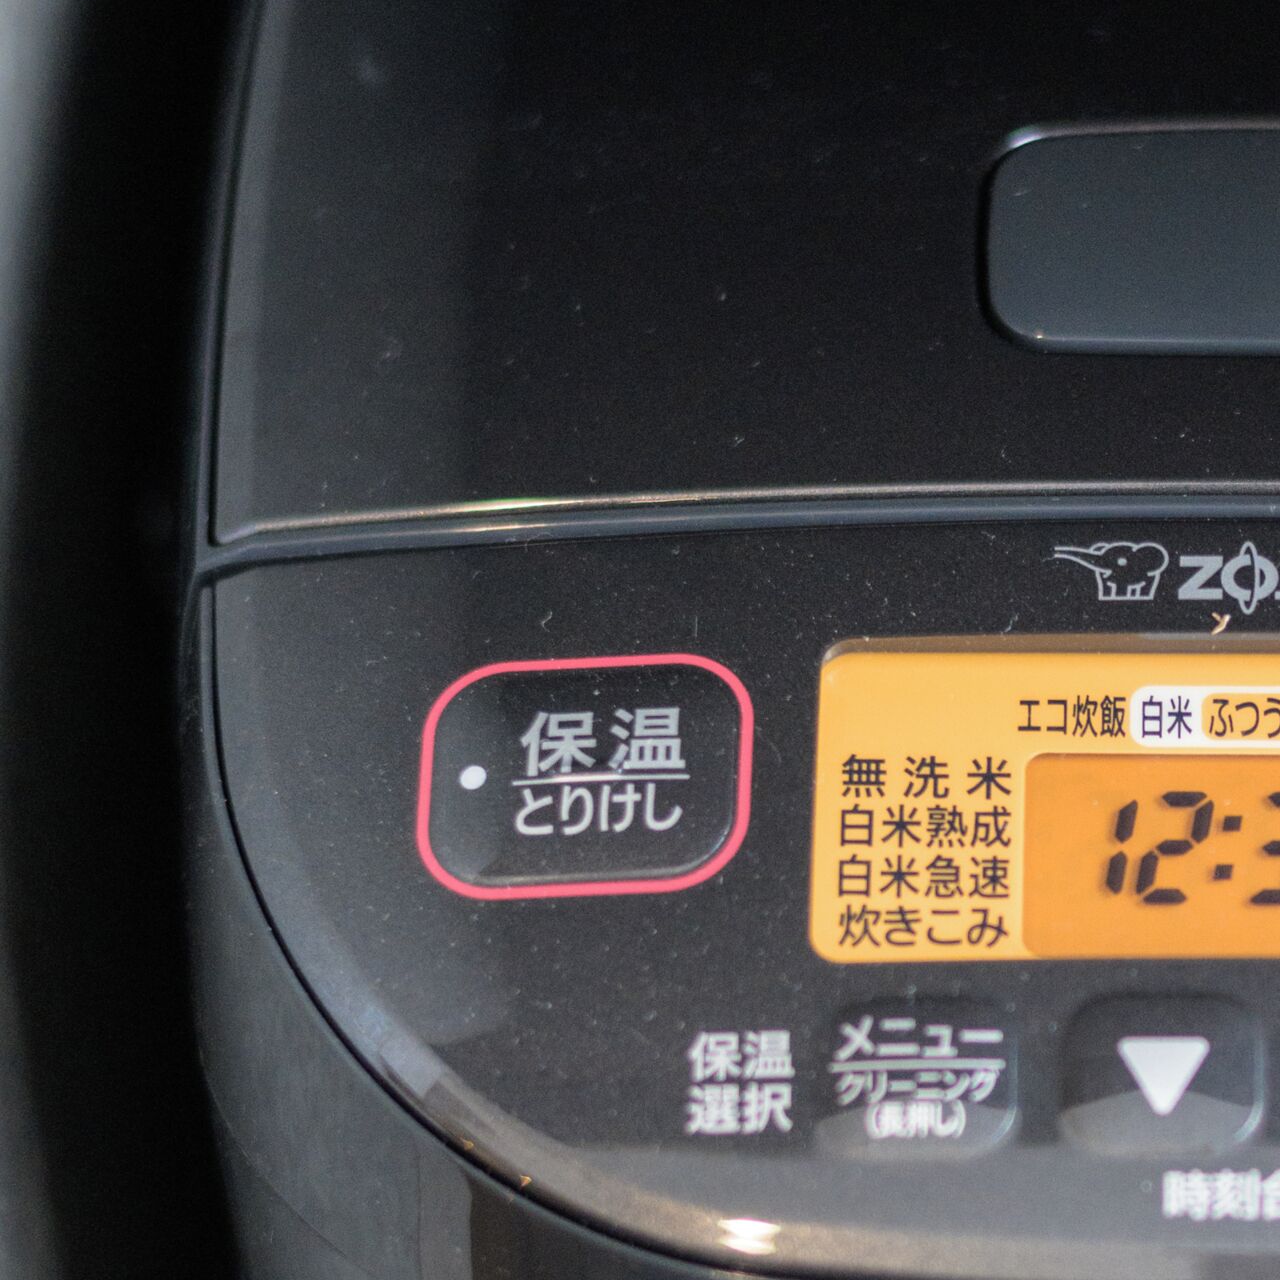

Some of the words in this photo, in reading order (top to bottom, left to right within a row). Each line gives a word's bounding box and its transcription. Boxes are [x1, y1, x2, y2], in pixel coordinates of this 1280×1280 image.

[1017, 695, 1126, 738] エコ炊飯
[1140, 697, 1193, 739] 白米
[519, 706, 686, 777] 保温
[840, 754, 1013, 799] 無洗米
[512, 785, 684, 836] とりけし
[839, 805, 1013, 849] 白米熟成
[838, 855, 1011, 900] 白米急速
[837, 905, 1009, 949] 炊きこみ
[686, 1029, 795, 1083] 保温
[833, 1014, 1004, 1062] メニュー
[684, 1083, 794, 1136] 選択
